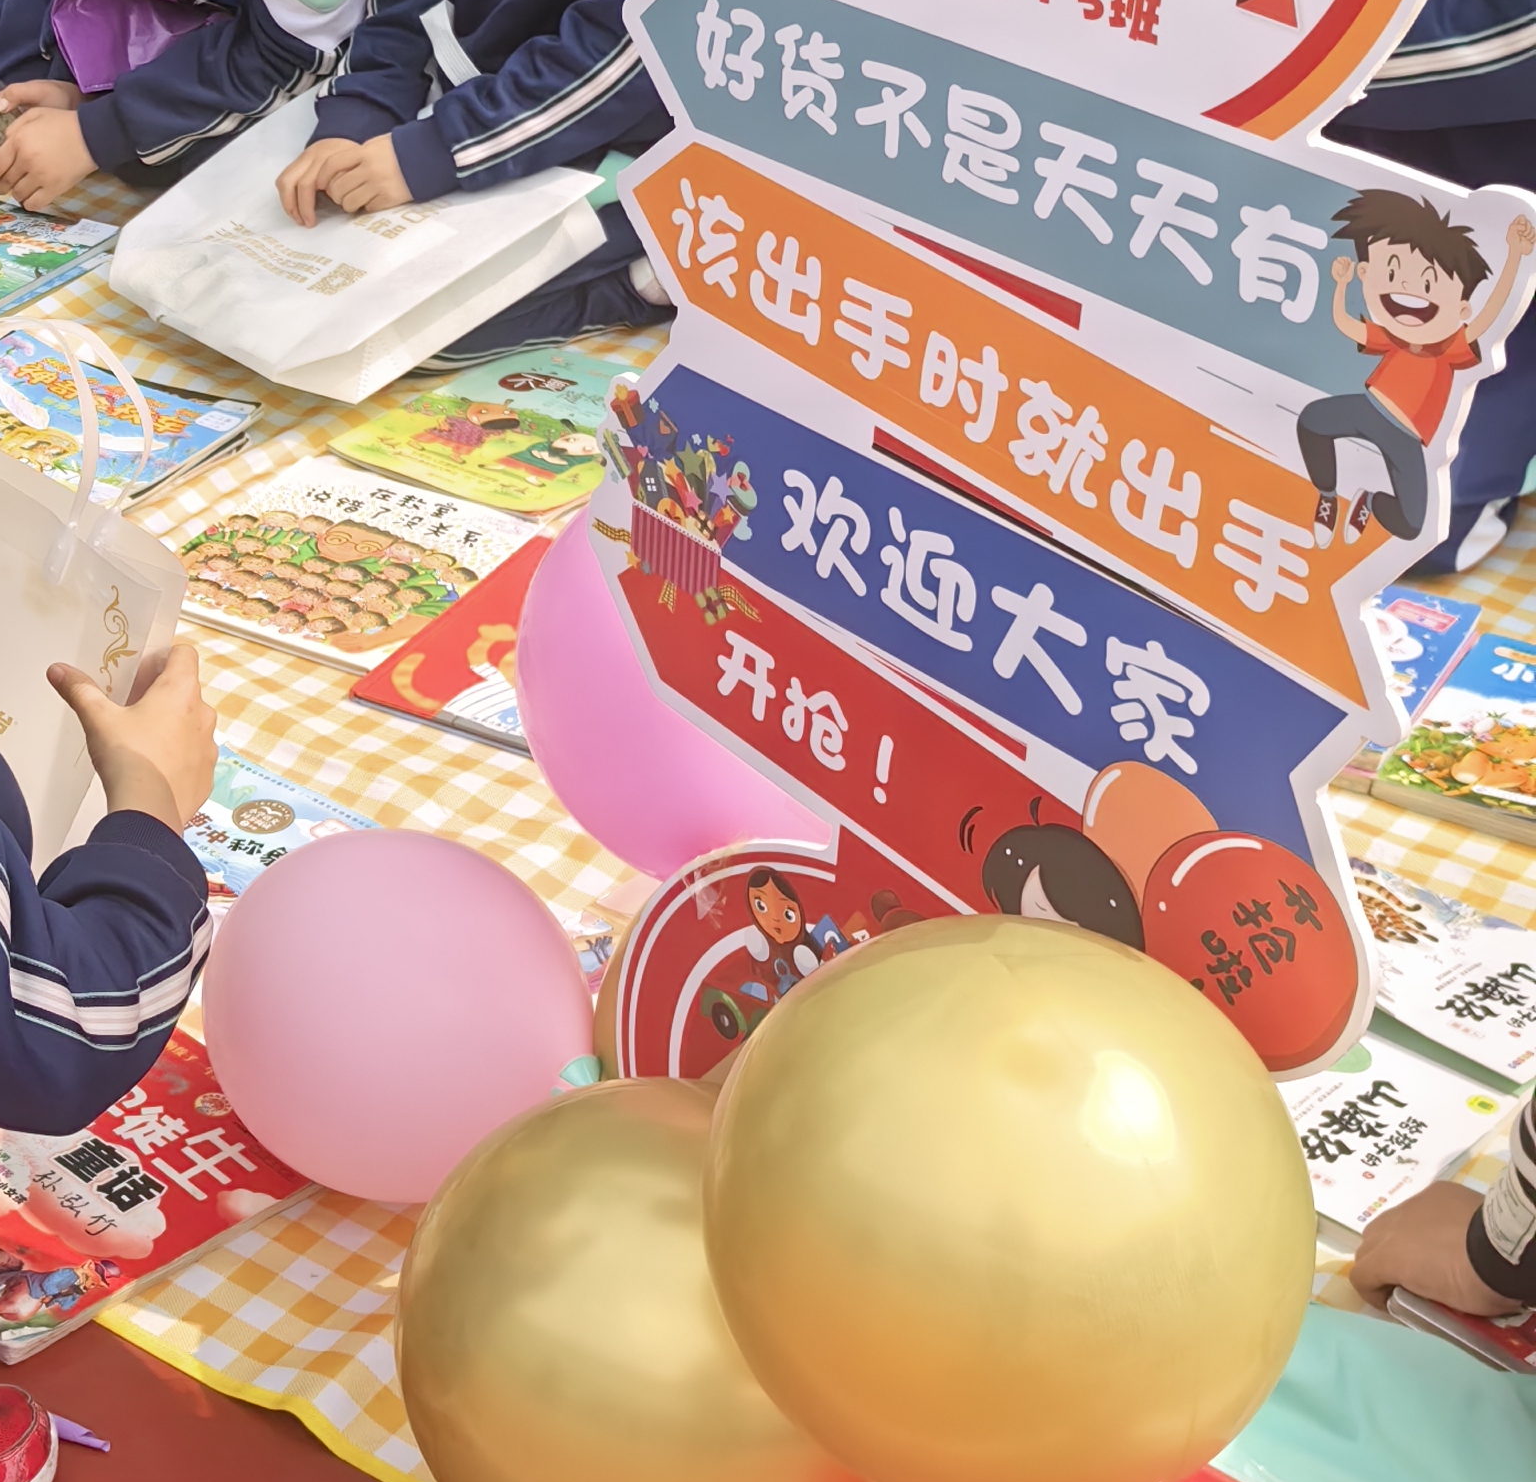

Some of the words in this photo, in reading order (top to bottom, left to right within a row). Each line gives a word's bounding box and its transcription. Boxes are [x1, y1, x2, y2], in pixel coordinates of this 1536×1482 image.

[669, 177, 1317, 614] 该出手时就出手
[779, 467, 1211, 776] 欢迎大家
[714, 629, 898, 805] 开抢！
[1190, 878, 1324, 1007] 开抢啦
[53, 1137, 166, 1213] 童话
